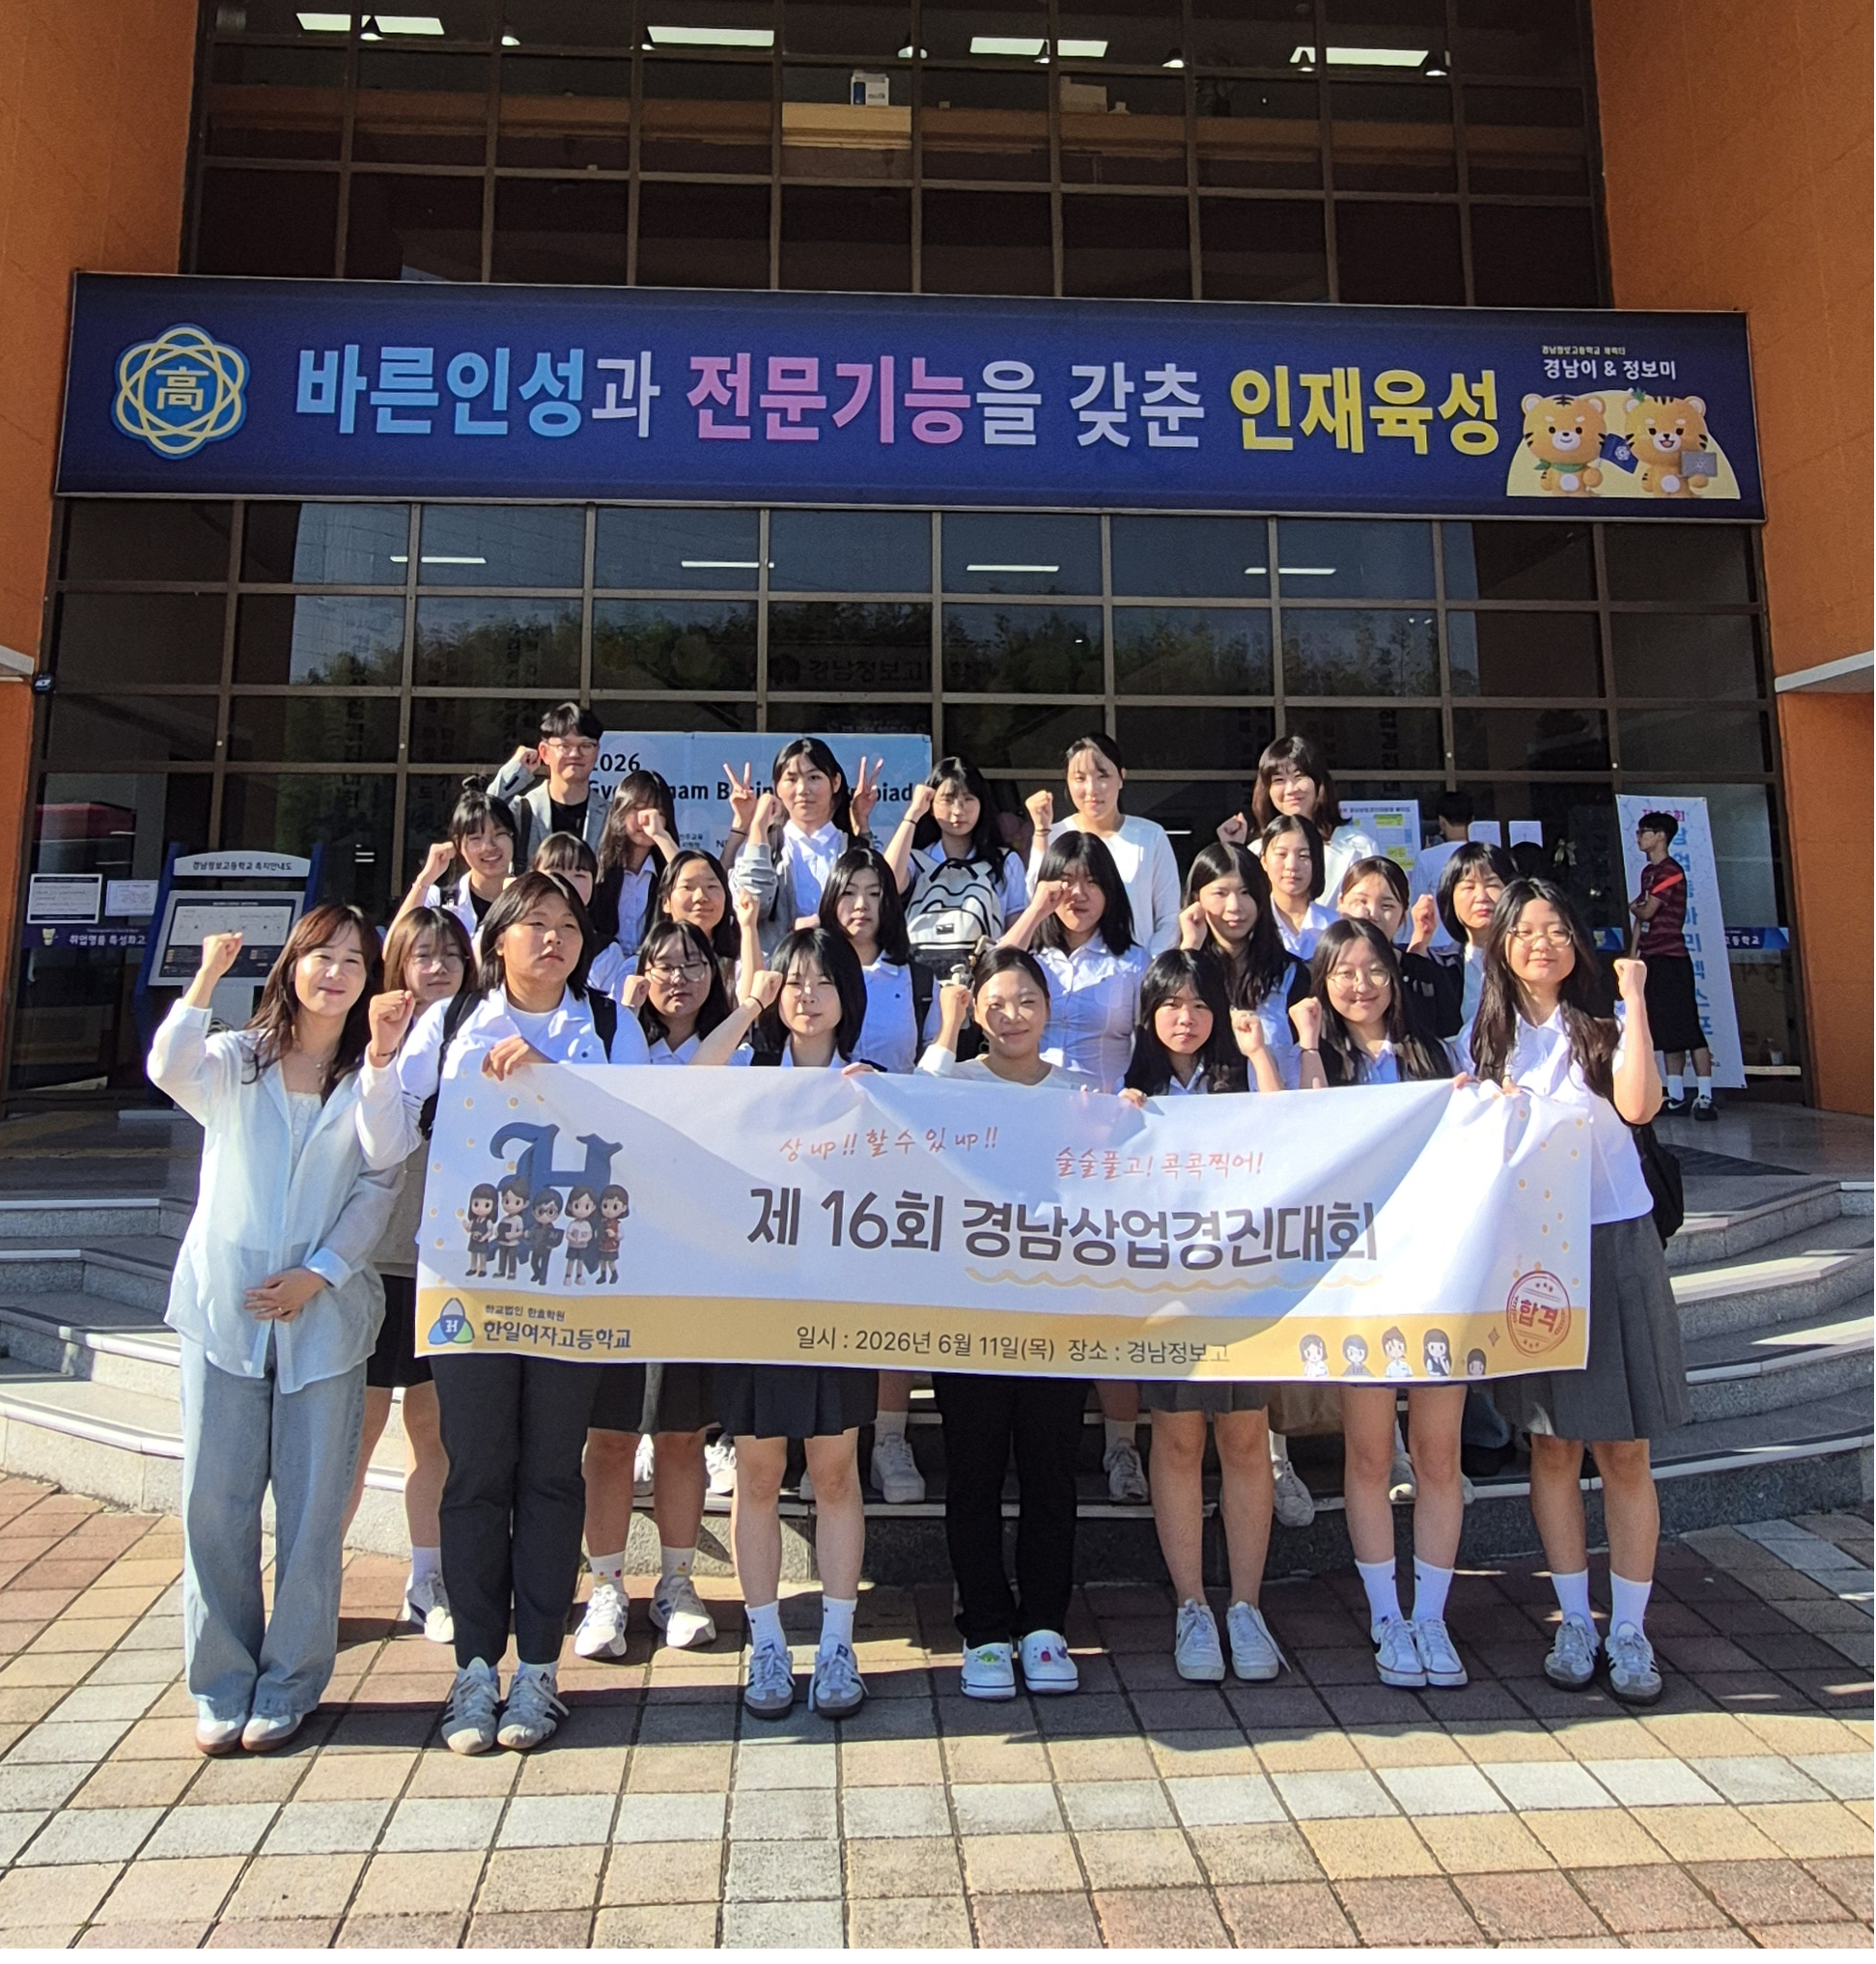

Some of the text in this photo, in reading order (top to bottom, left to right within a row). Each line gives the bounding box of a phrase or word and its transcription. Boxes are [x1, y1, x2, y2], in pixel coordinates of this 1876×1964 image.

[1543, 358, 1676, 380] 경남이 & 정보미
[155, 366, 204, 412] 高
[295, 344, 1499, 456] 바른인성과 전문기능을 갖춘 인재육성
[593, 753, 641, 772] 026
[779, 1137, 803, 1163] 상
[894, 1129, 916, 1155] 수
[925, 1127, 947, 1153] 있
[1055, 1146, 1264, 1181] 술술풀고! 콕콕찍어!
[746, 1187, 1378, 1271] 제 16회 경남상업경진대회
[485, 1305, 524, 1317] 학교법인
[1519, 1300, 1558, 1333] 합격
[484, 1321, 632, 1351] 한일여자고등학교
[797, 1326, 836, 1351] 일시
[855, 1330, 931, 1355] 2026년
[938, 1333, 971, 1357] 6월
[979, 1336, 1055, 1362] 11일(목)
[1068, 1338, 1108, 1362] 장소
[1127, 1339, 1231, 1364] 경남정보고
